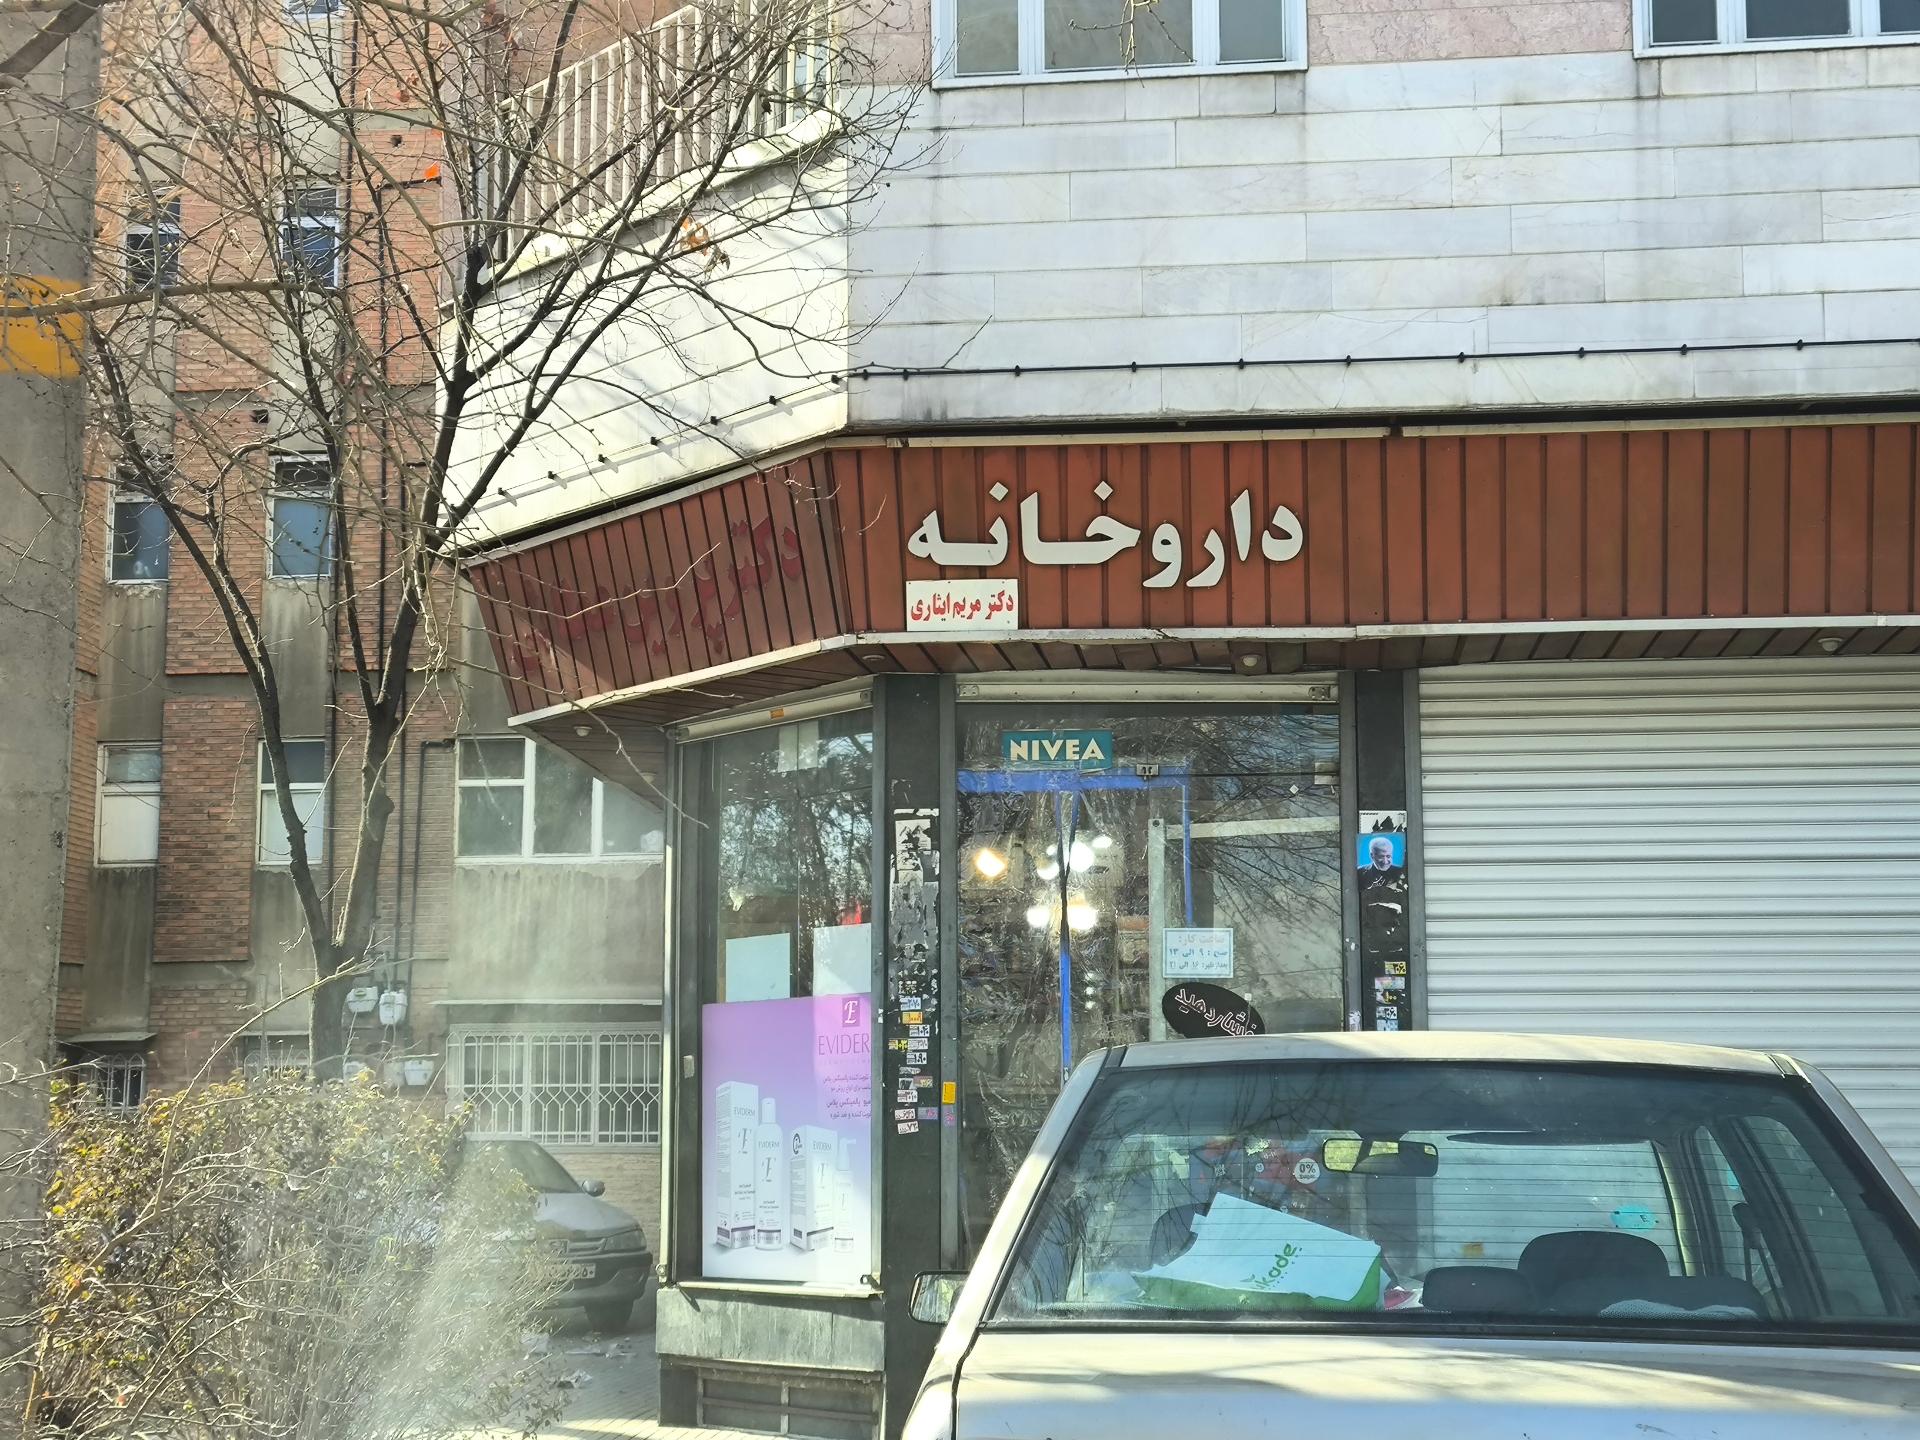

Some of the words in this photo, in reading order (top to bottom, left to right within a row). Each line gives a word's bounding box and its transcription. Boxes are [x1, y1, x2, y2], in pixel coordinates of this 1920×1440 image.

[908, 481, 1304, 588] داروخانه
[911, 592, 950, 622] ایثاری
[953, 597, 982, 619] مریم
[985, 590, 1014, 620] دکتر
[1010, 738, 1105, 761] NIVEA
[1299, 1164, 1316, 1174] 0%
